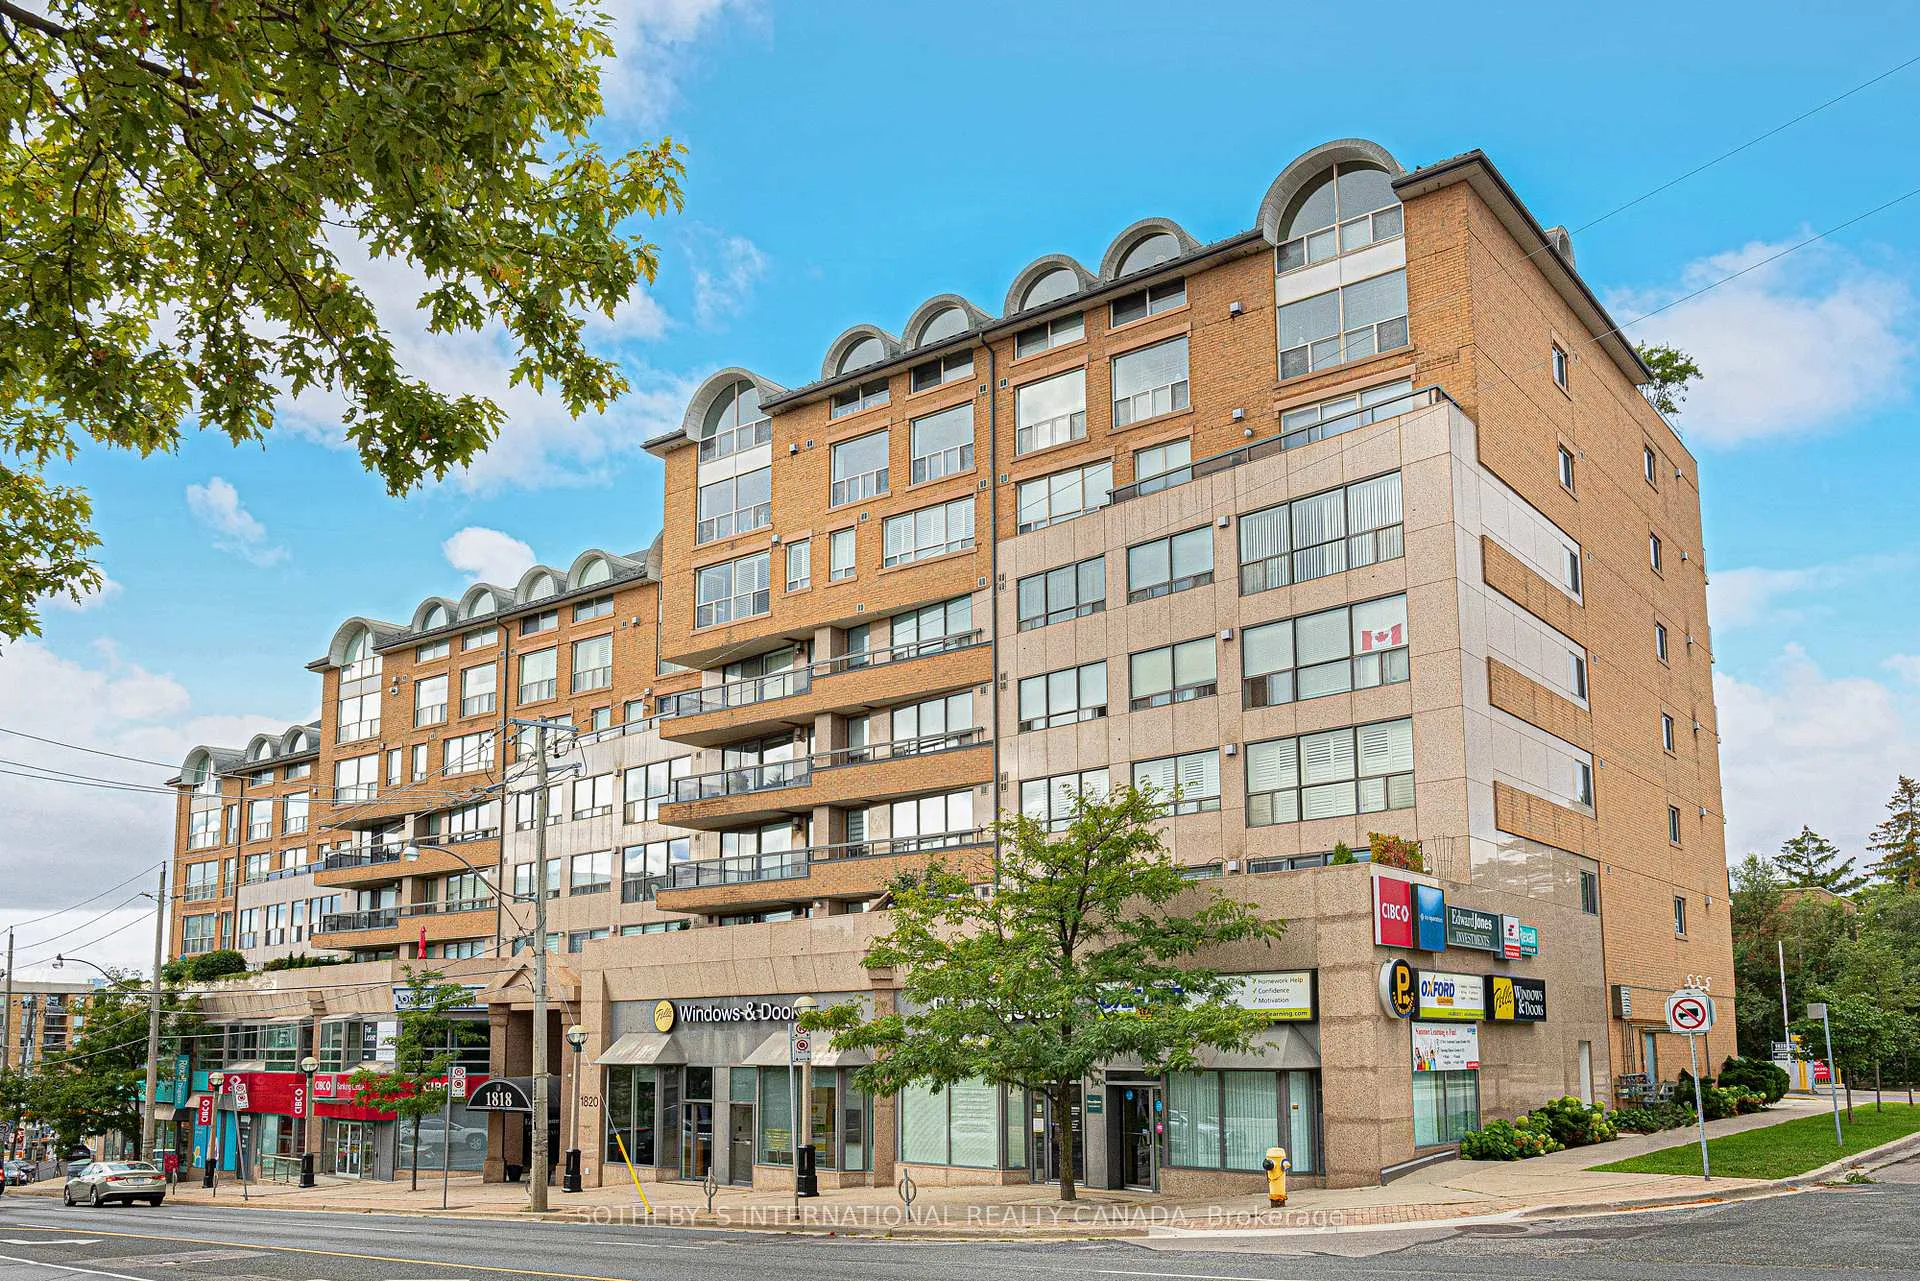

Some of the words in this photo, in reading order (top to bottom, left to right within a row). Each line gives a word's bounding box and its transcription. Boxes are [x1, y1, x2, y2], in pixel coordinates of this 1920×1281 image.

[1382, 903, 1401, 920] CIBC
[1456, 931, 1490, 946] INVESTMENTS
[1289, 976, 1304, 984] Help
[1421, 980, 1455, 998] OXFORD
[679, 1004, 740, 1023] Windows
[745, 1001, 756, 1021] &
[761, 1003, 798, 1021] Door
[1518, 999, 1525, 1014] &
[485, 1091, 512, 1106] 1818
[580, 1095, 599, 1107] 1820
